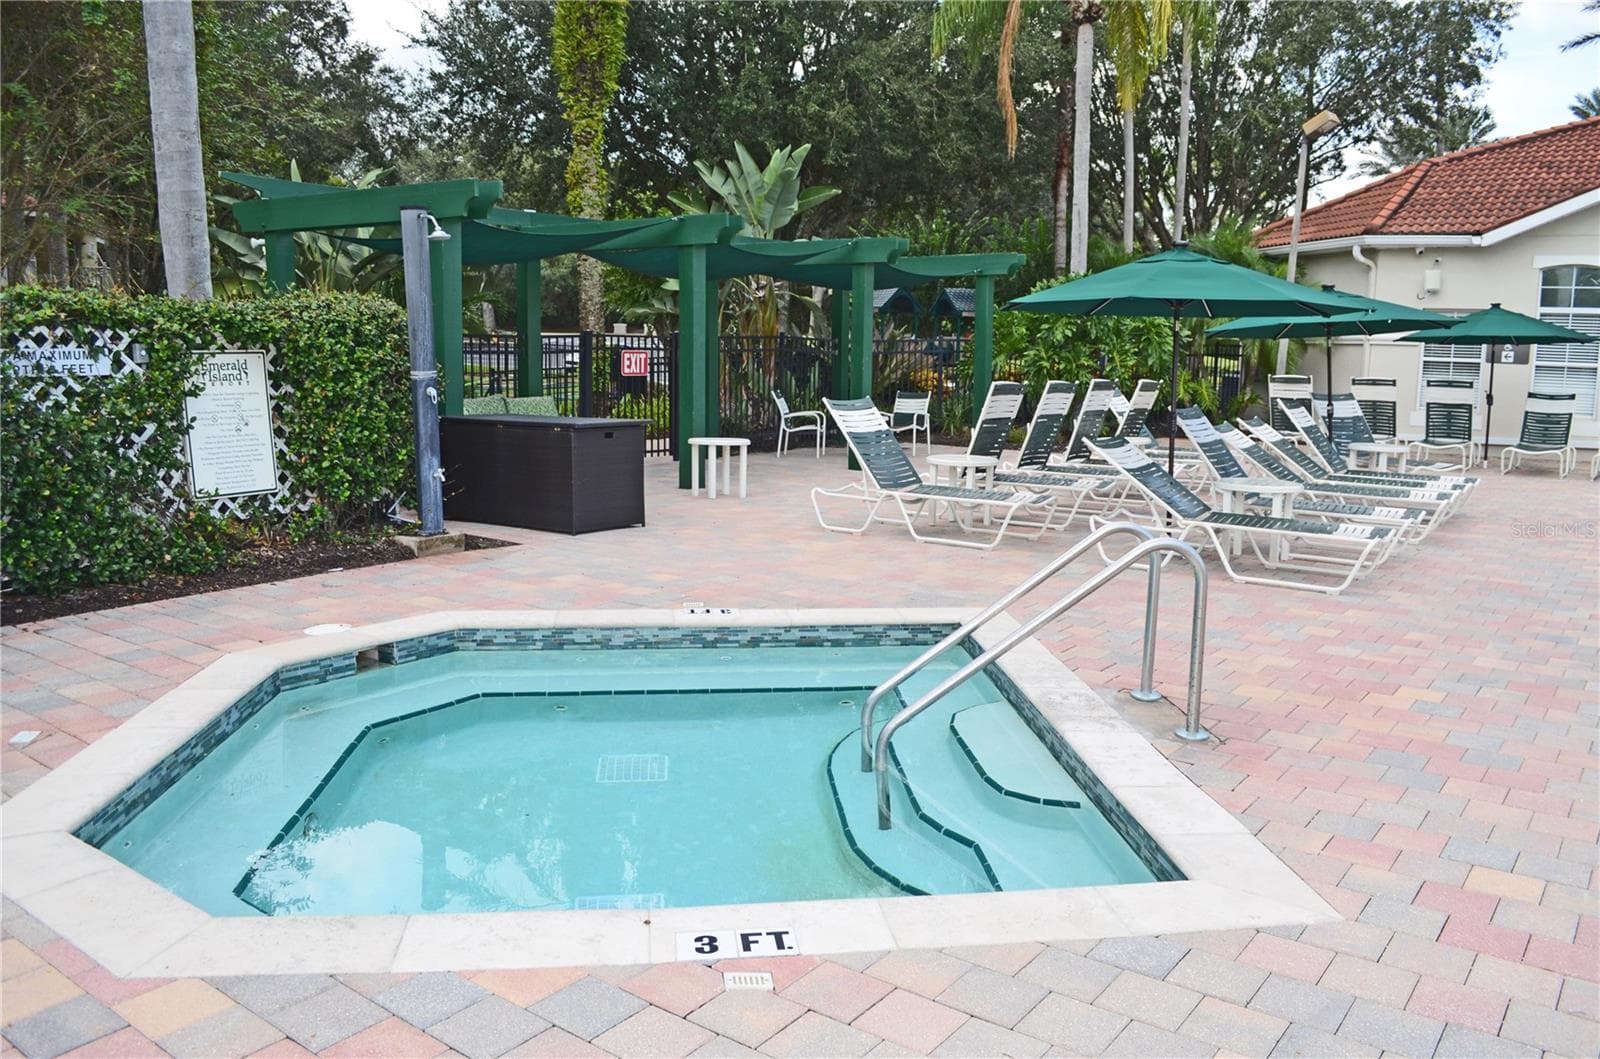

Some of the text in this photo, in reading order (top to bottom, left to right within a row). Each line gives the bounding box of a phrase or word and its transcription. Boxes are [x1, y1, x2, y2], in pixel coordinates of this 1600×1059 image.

[28, 350, 93, 361] MAXIMUM
[202, 359, 249, 371] Emerald
[624, 352, 647, 374] EXIT
[61, 364, 94, 374] FEET
[208, 370, 243, 381] Island
[694, 931, 794, 954] 3 FT.
